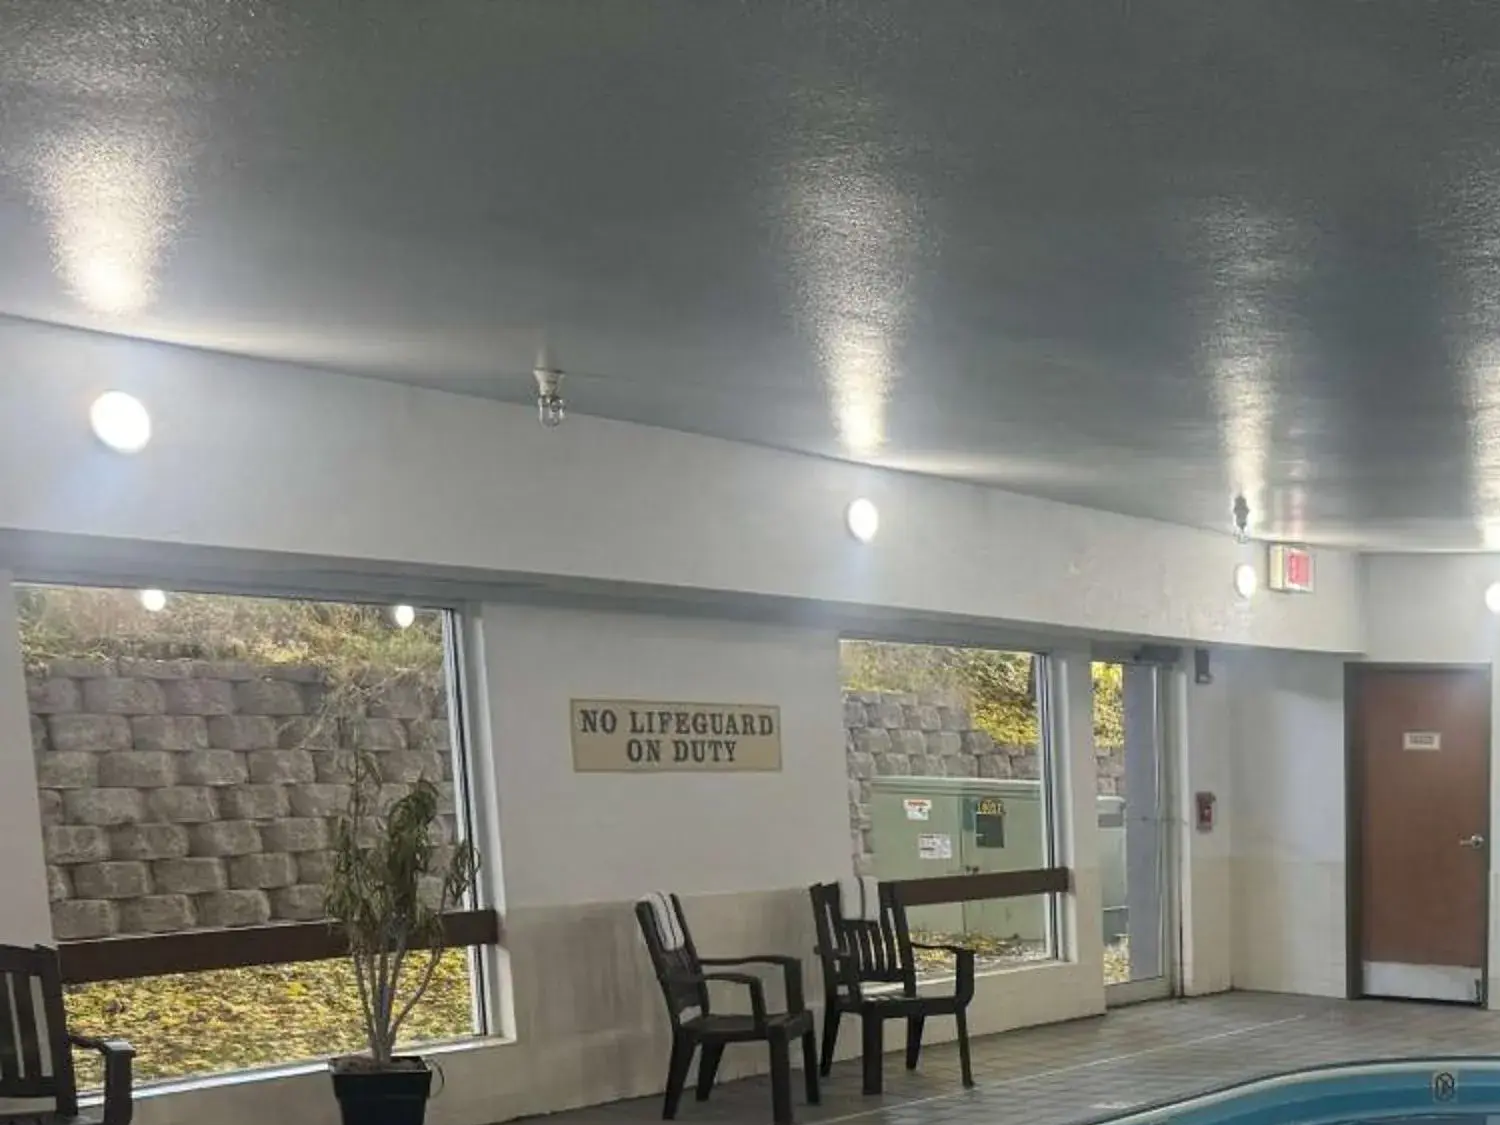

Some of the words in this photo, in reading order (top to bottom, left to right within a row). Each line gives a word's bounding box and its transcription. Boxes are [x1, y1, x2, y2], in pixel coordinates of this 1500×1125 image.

[580, 709, 617, 734] NO
[629, 711, 774, 736] LIFEGUARD
[627, 738, 662, 763] ON
[672, 740, 737, 763] DUTY
